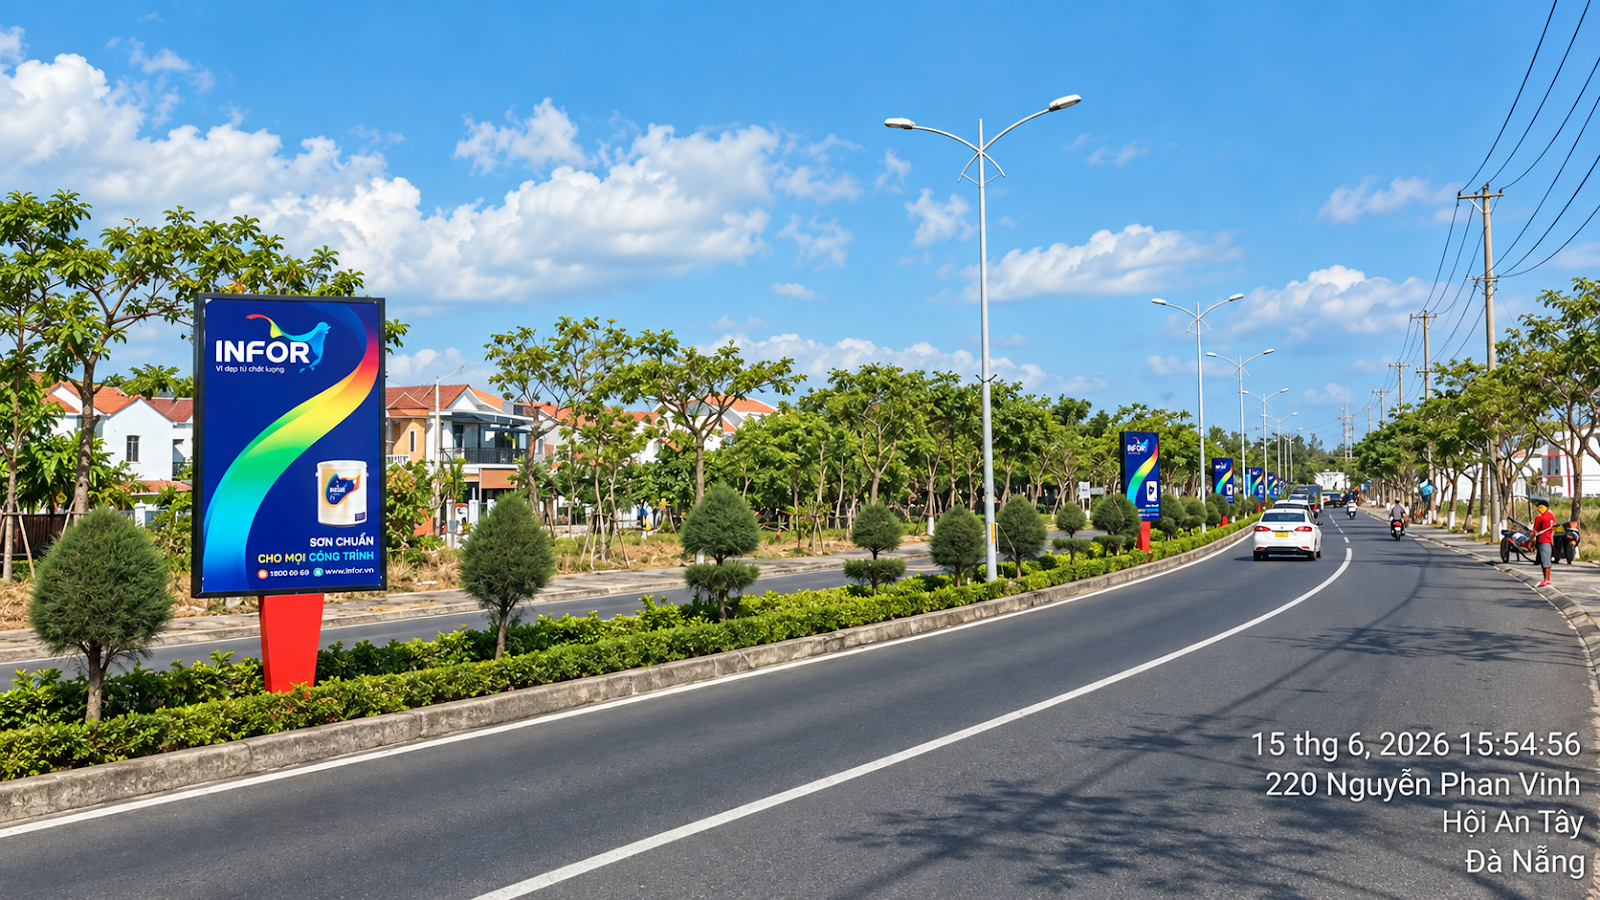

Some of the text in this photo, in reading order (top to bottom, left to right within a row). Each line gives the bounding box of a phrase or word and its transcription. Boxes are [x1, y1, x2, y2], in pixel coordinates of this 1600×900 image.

[216, 340, 310, 363] INFOR
[309, 532, 374, 547] SƠN CHUẨN
[257, 553, 282, 564] CHO
[285, 552, 306, 565] MỌI
